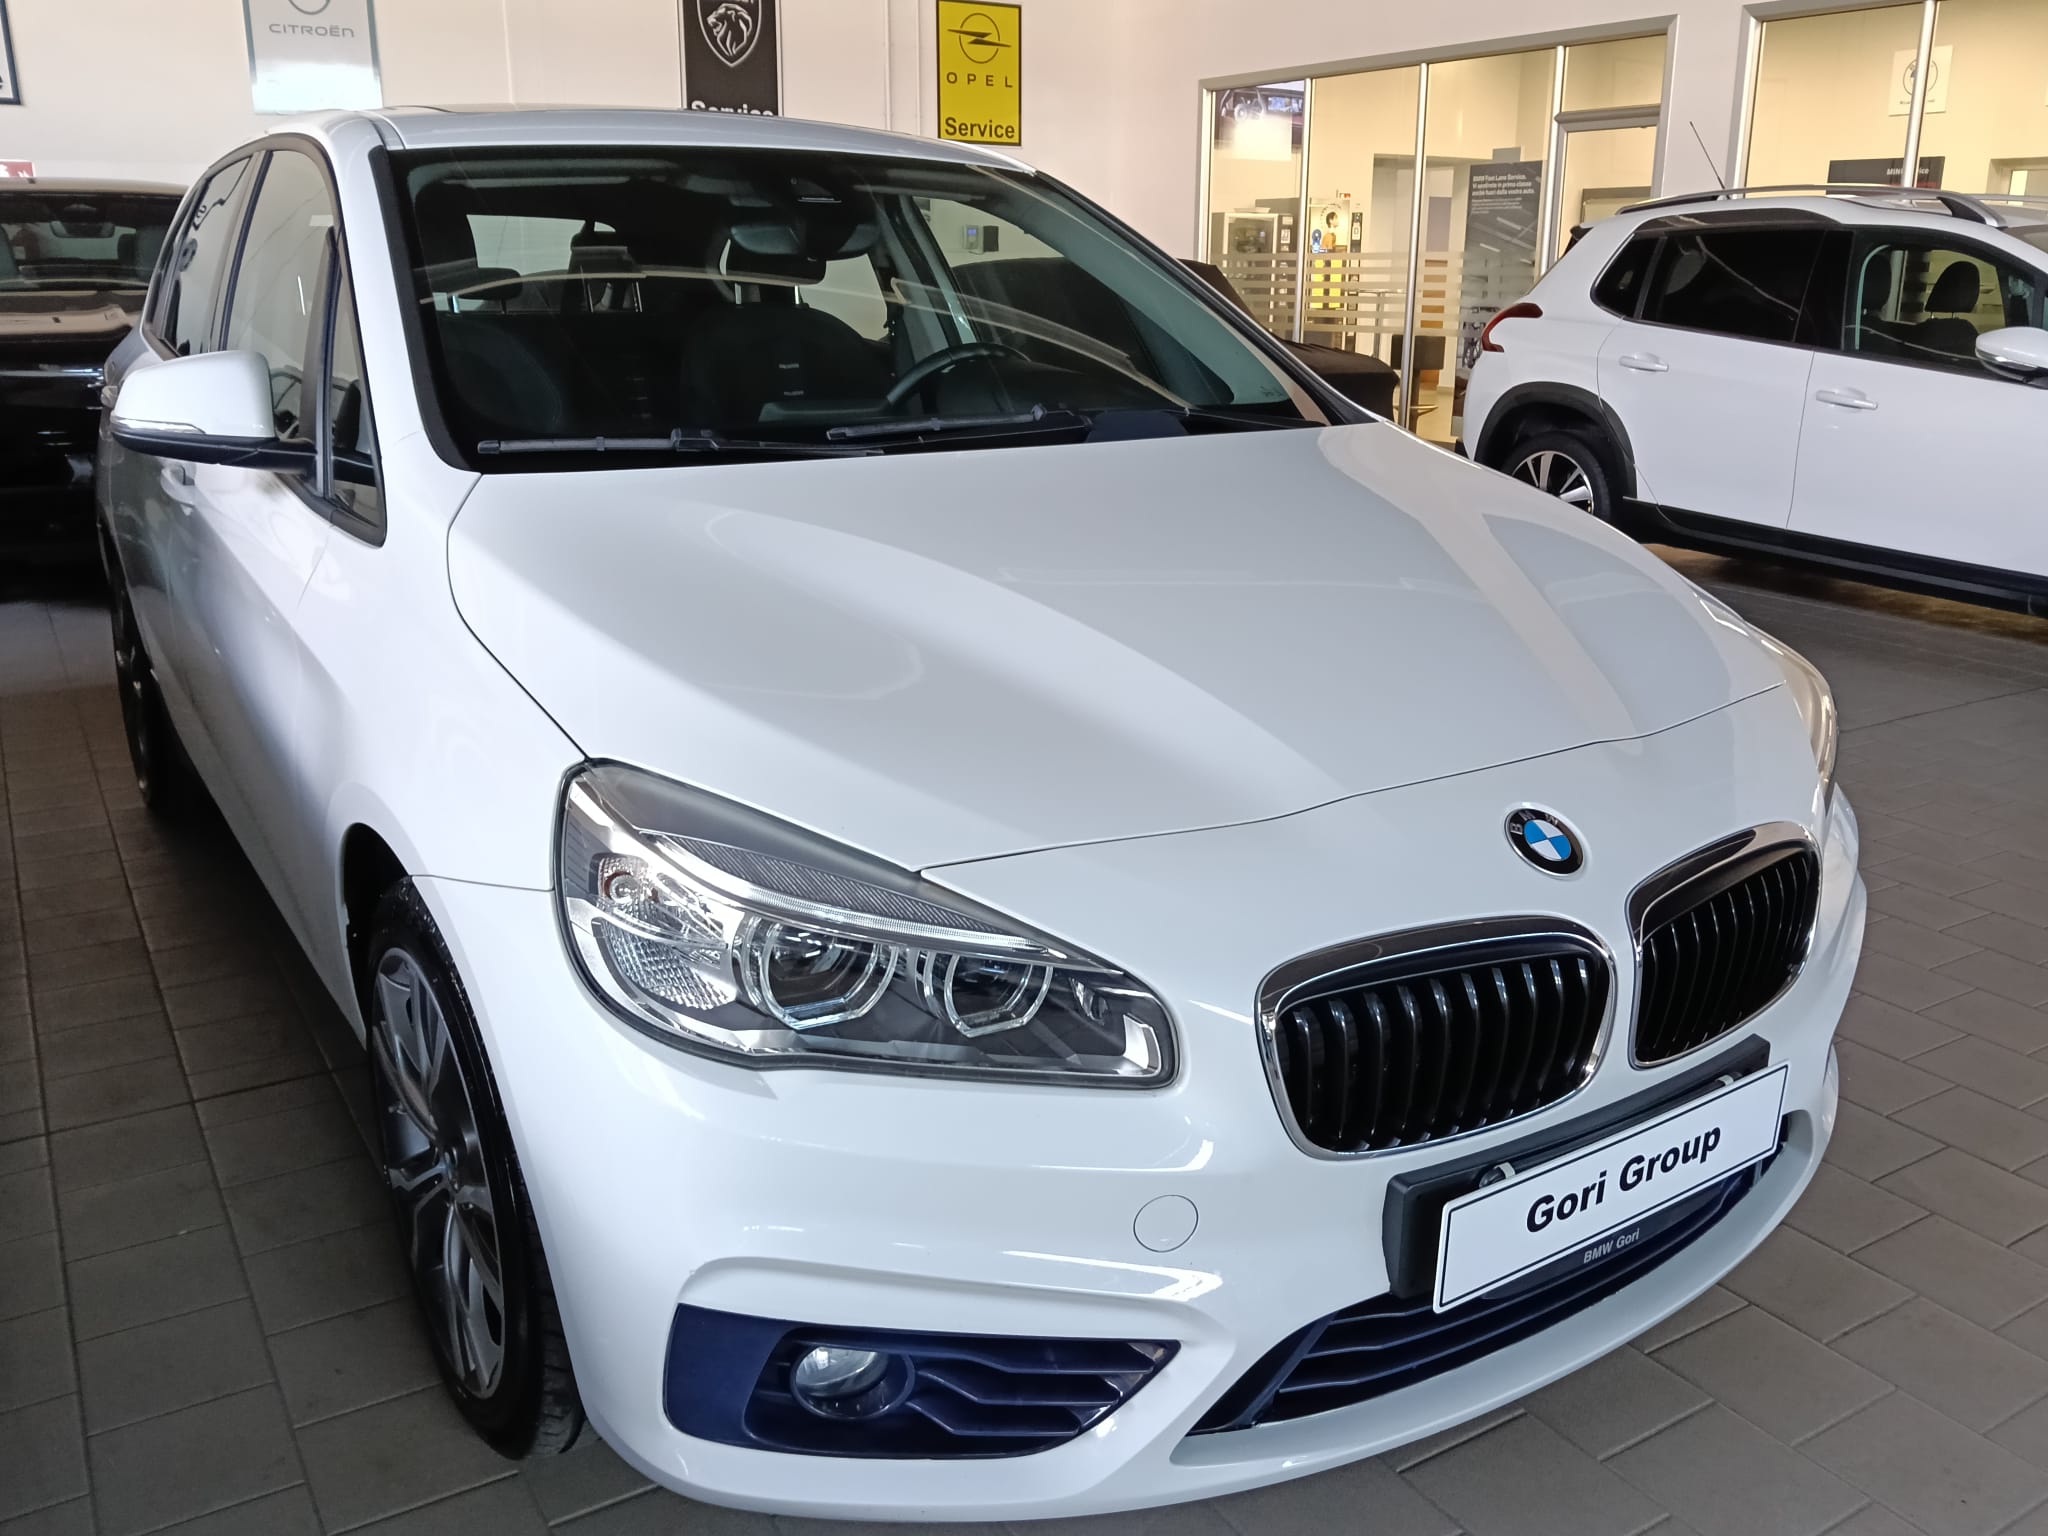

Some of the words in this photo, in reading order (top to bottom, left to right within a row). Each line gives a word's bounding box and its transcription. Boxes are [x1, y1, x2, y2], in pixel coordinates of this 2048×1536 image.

[946, 72, 1013, 88] OPEL
[945, 116, 1016, 139] Service
[1509, 809, 1559, 836] BMW
[1526, 1169, 1607, 1233] Gori
[1619, 1126, 1721, 1192] Group
[1583, 1240, 1614, 1264] BMW
[1616, 1227, 1640, 1249] Gori
